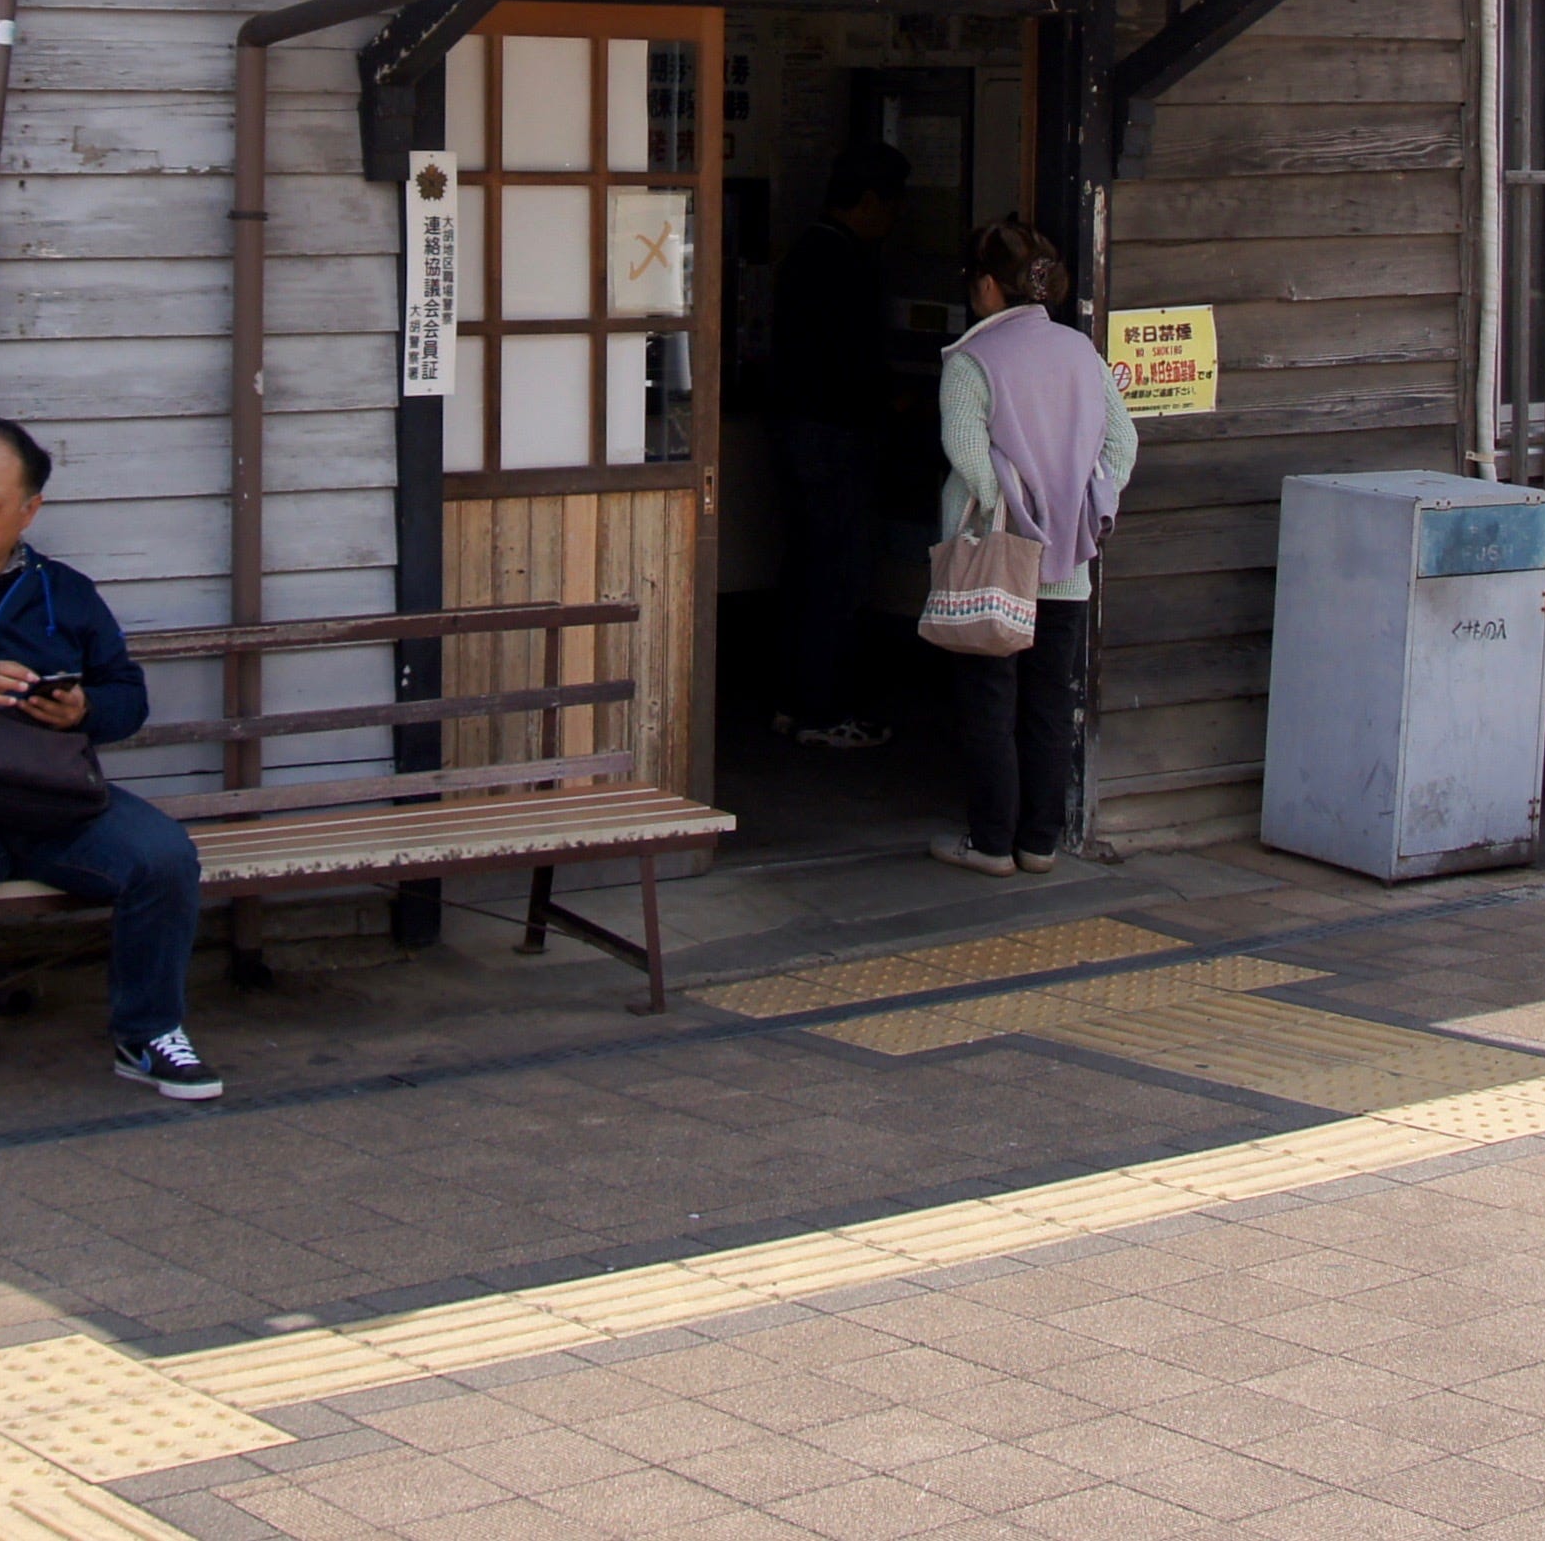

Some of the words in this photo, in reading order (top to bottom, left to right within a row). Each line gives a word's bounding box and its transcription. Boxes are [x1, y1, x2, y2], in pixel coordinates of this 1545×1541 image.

[423, 216, 441, 380] 連絡協議会会員証
[443, 215, 454, 325] 大胡地区職場警察
[408, 305, 421, 380] 大胡警察署
[1124, 324, 1192, 344] 終日禁煙
